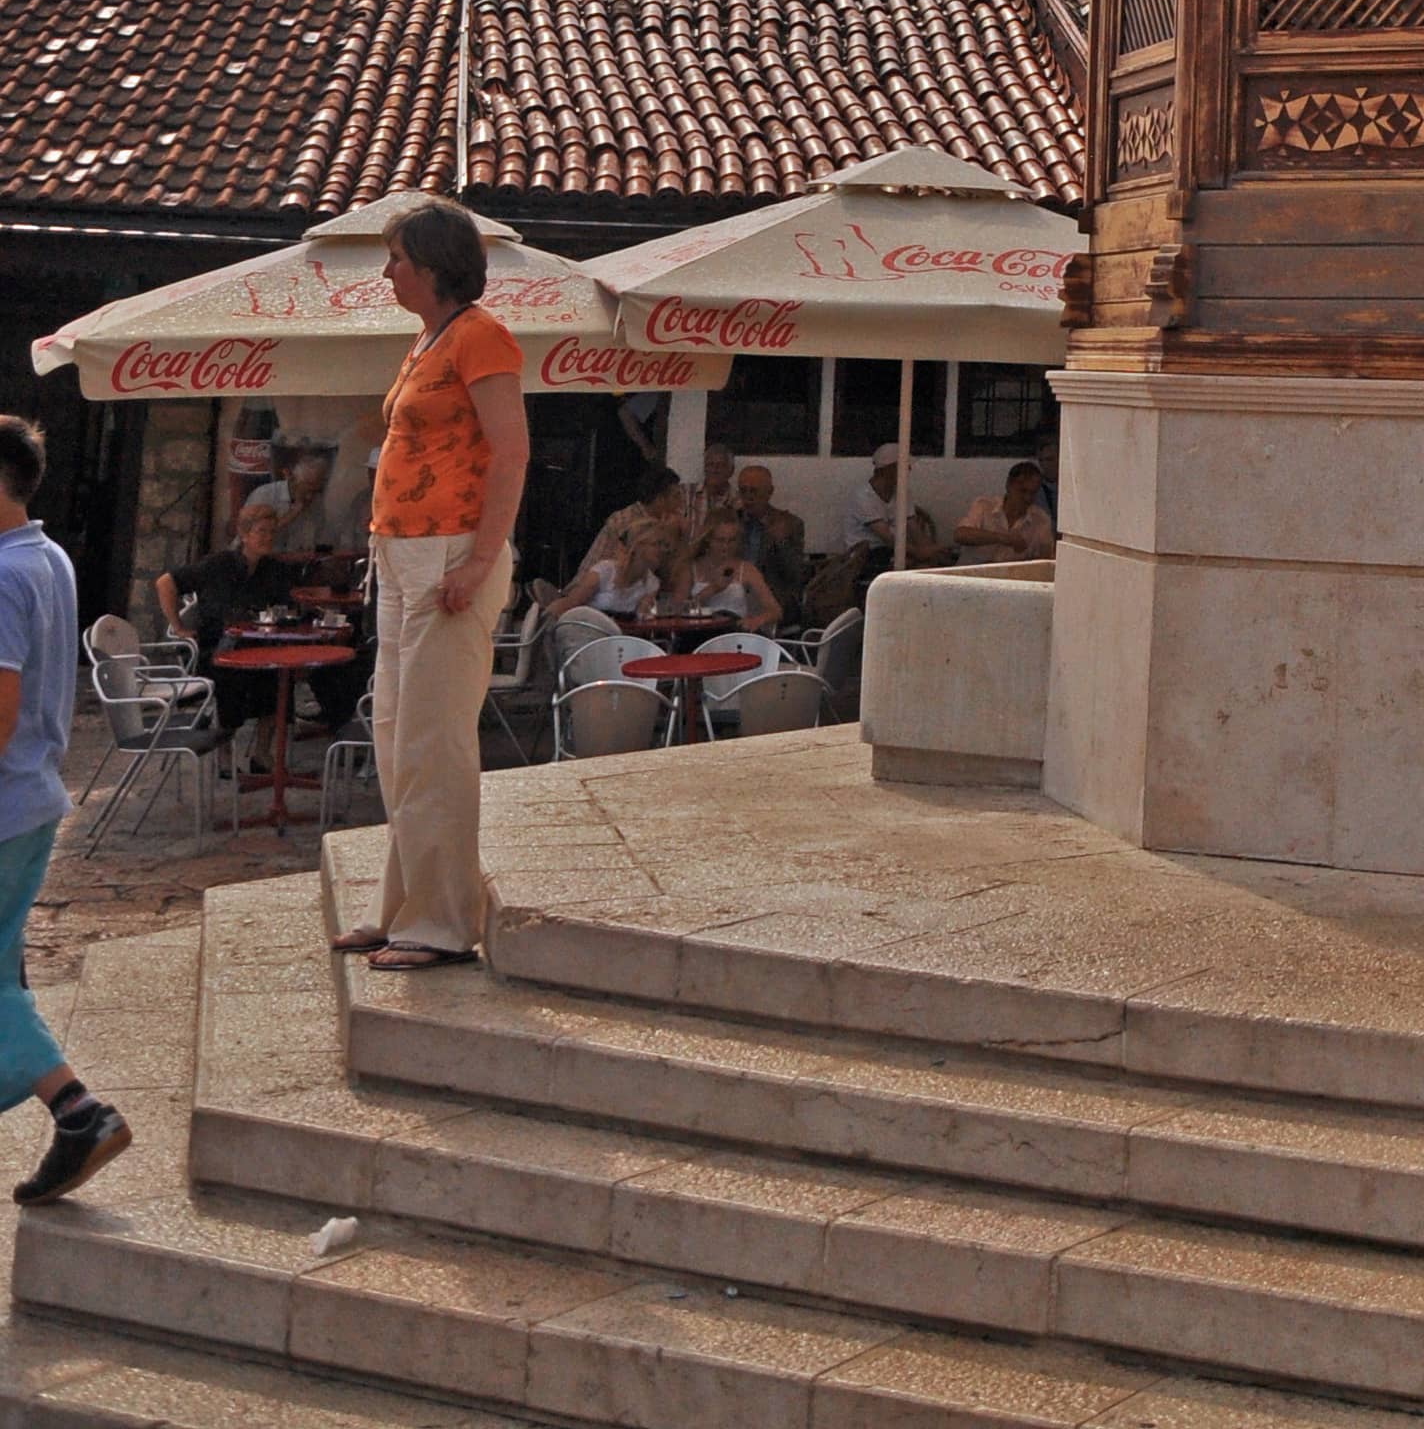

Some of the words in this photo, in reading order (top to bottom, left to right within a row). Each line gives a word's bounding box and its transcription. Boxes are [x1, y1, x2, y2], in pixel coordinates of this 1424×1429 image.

[881, 244, 1075, 279] Coca-Col
[999, 281, 1064, 301] Osvje
[646, 295, 804, 348] Coca-Cola
[111, 338, 282, 393] Coca-Cola
